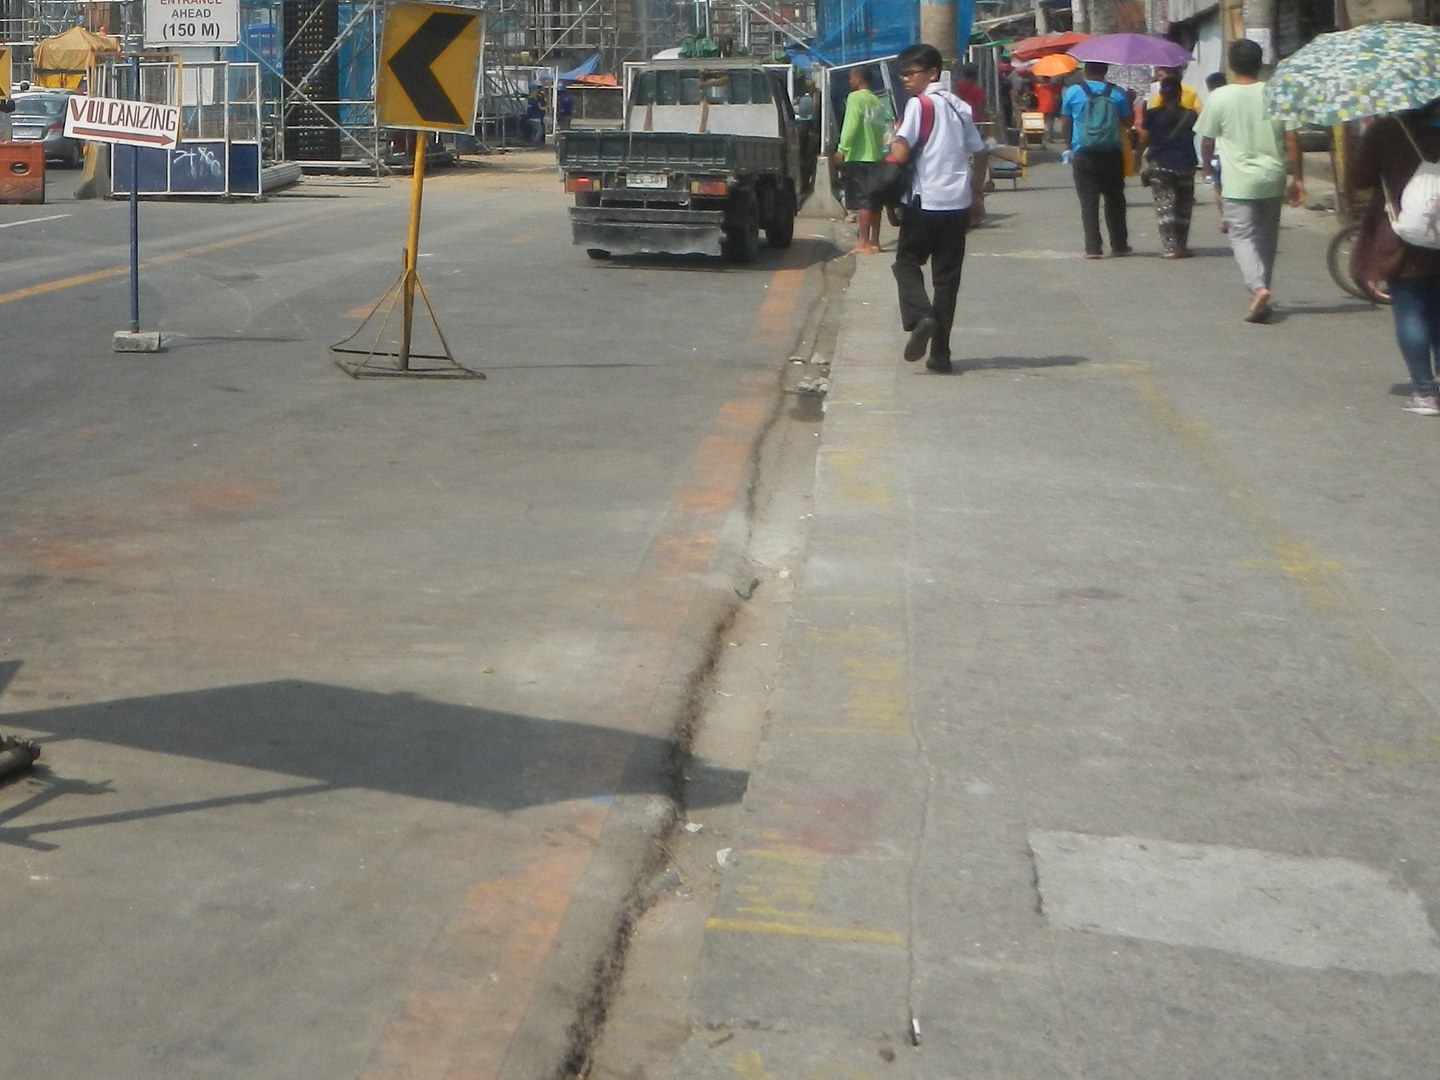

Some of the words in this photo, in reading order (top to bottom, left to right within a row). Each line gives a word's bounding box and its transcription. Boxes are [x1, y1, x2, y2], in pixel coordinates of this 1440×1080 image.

[171, 9, 211, 18] AHEAD
[163, 23, 196, 40] (150
[201, 23, 220, 39] M)
[69, 98, 177, 132] VULCANIZING
